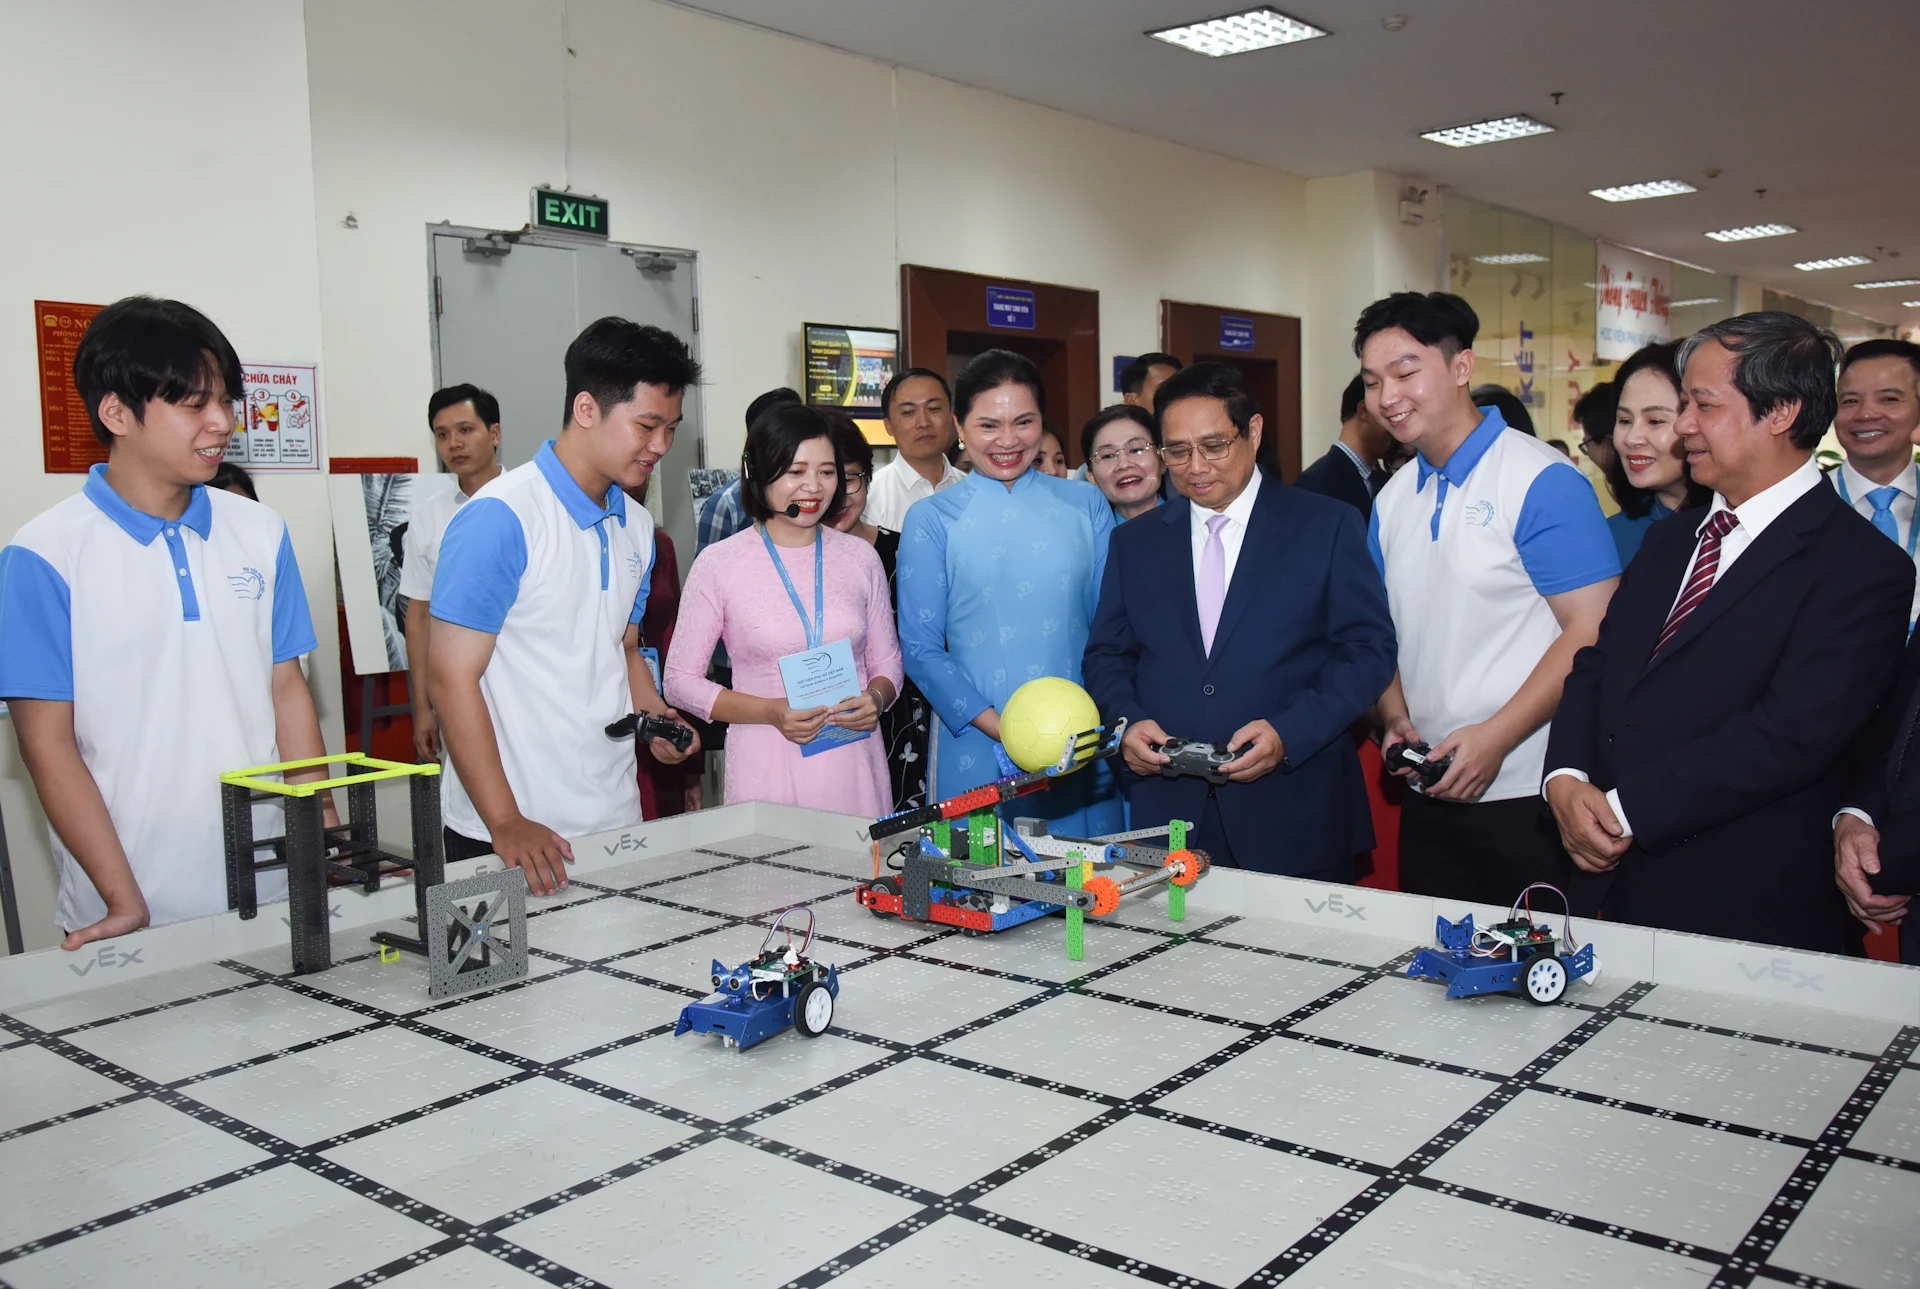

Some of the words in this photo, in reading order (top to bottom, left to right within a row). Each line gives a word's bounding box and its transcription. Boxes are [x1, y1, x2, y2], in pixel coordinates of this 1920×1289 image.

[545, 198, 600, 228] EXIT
[244, 371, 270, 385] CHỮA
[272, 372, 297, 385] CHÁY
[258, 391, 265, 399] 3
[290, 392, 297, 400] 4
[603, 833, 648, 856] VEX
[1304, 893, 1367, 921] VEX
[67, 945, 144, 977] VEX
[1491, 974, 1505, 984] KC
